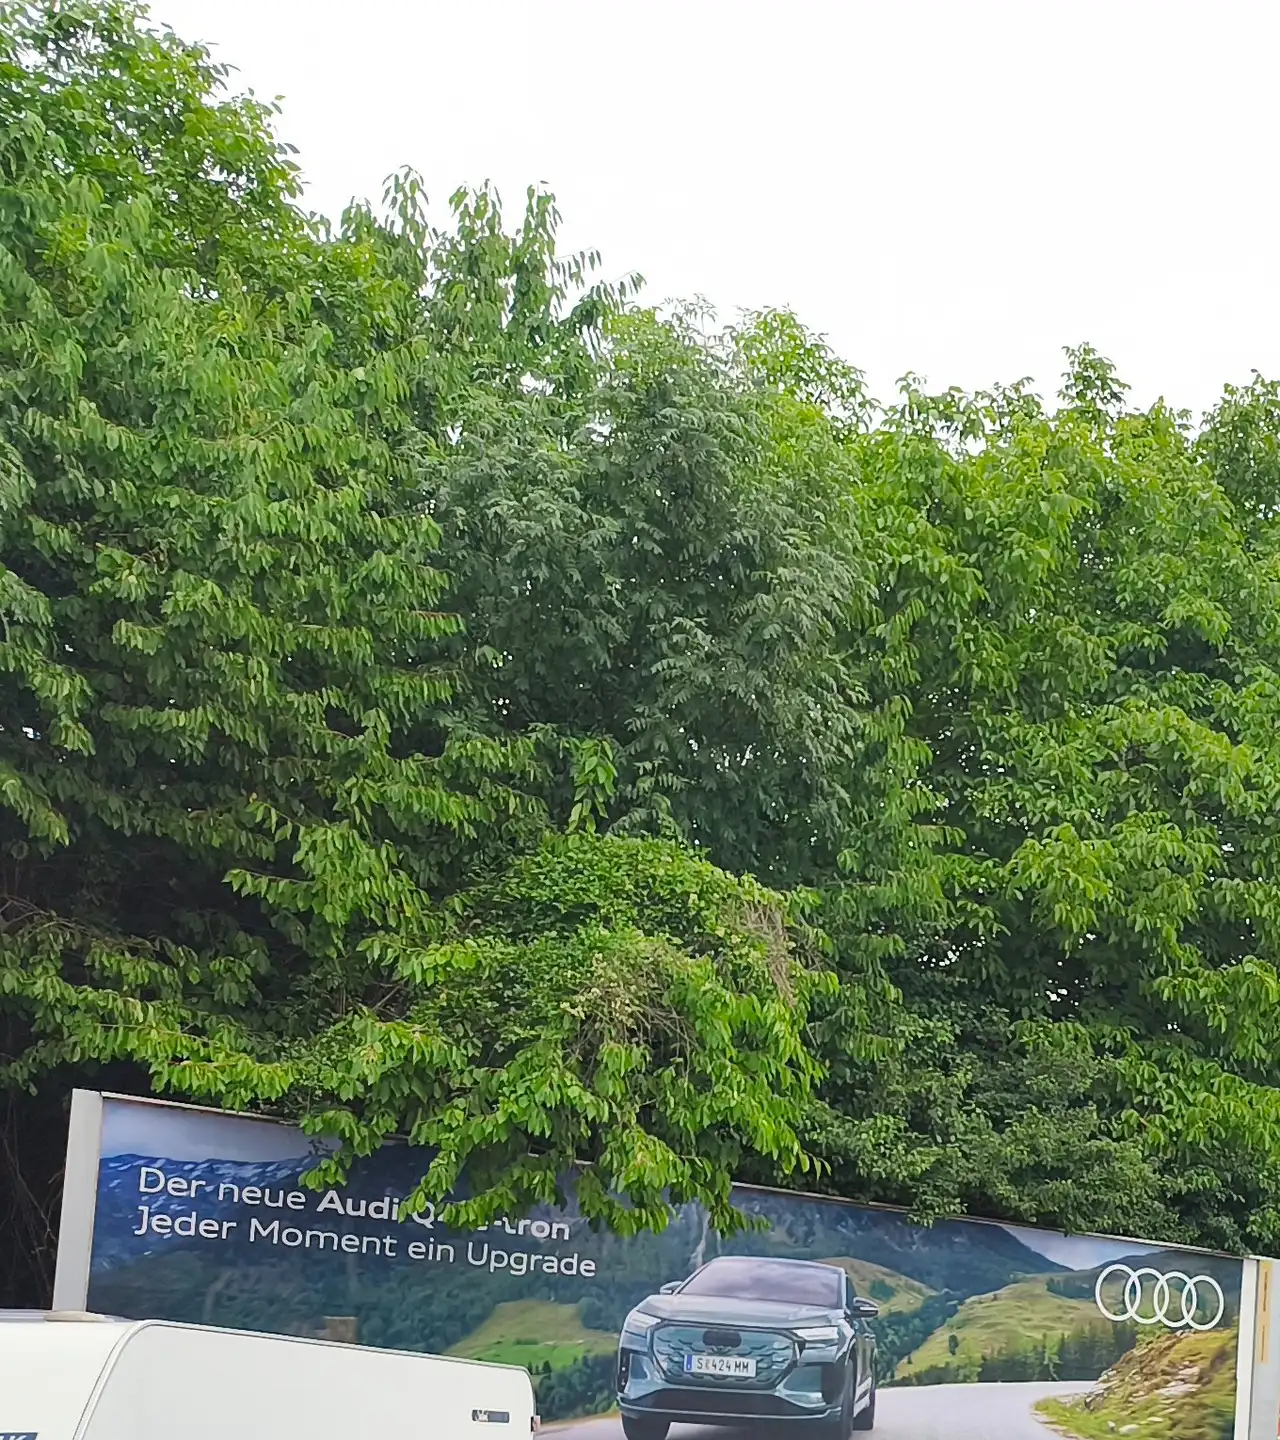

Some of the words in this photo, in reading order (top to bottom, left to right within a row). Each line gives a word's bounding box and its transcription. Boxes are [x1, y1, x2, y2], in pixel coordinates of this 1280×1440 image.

[139, 1166, 206, 1198] Der
[218, 1182, 306, 1210] neue
[317, 1190, 399, 1221] Audi
[134, 1206, 237, 1240] Jeder
[249, 1217, 397, 1257] Moment
[408, 1237, 455, 1263] ein
[467, 1242, 597, 1278] Upgrade
